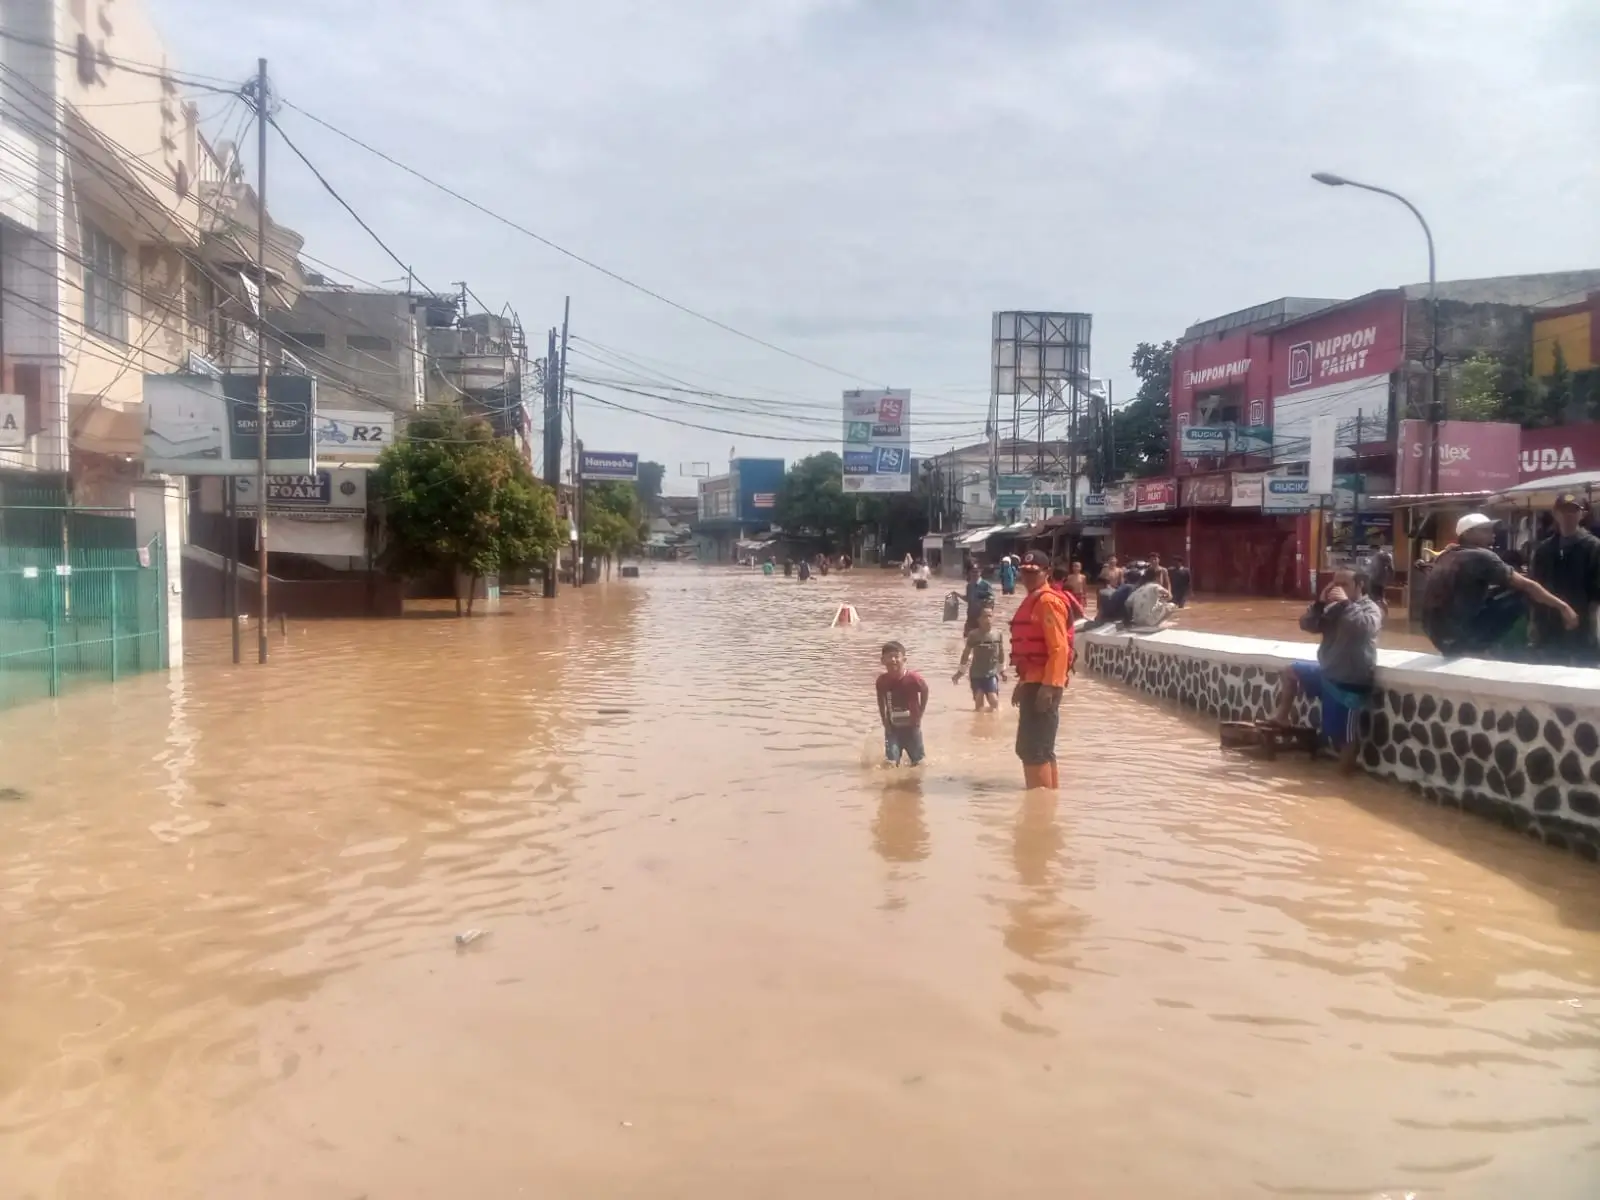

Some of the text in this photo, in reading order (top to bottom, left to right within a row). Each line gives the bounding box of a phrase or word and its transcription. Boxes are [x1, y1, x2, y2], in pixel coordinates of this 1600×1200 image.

[1314, 326, 1377, 359] NIPPON
[1320, 349, 1368, 377] PAINT
[1190, 365, 1225, 385] NIPPON
[352, 426, 382, 441] R2
[1518, 447, 1577, 473] UDA
[269, 486, 321, 498] FOAM
